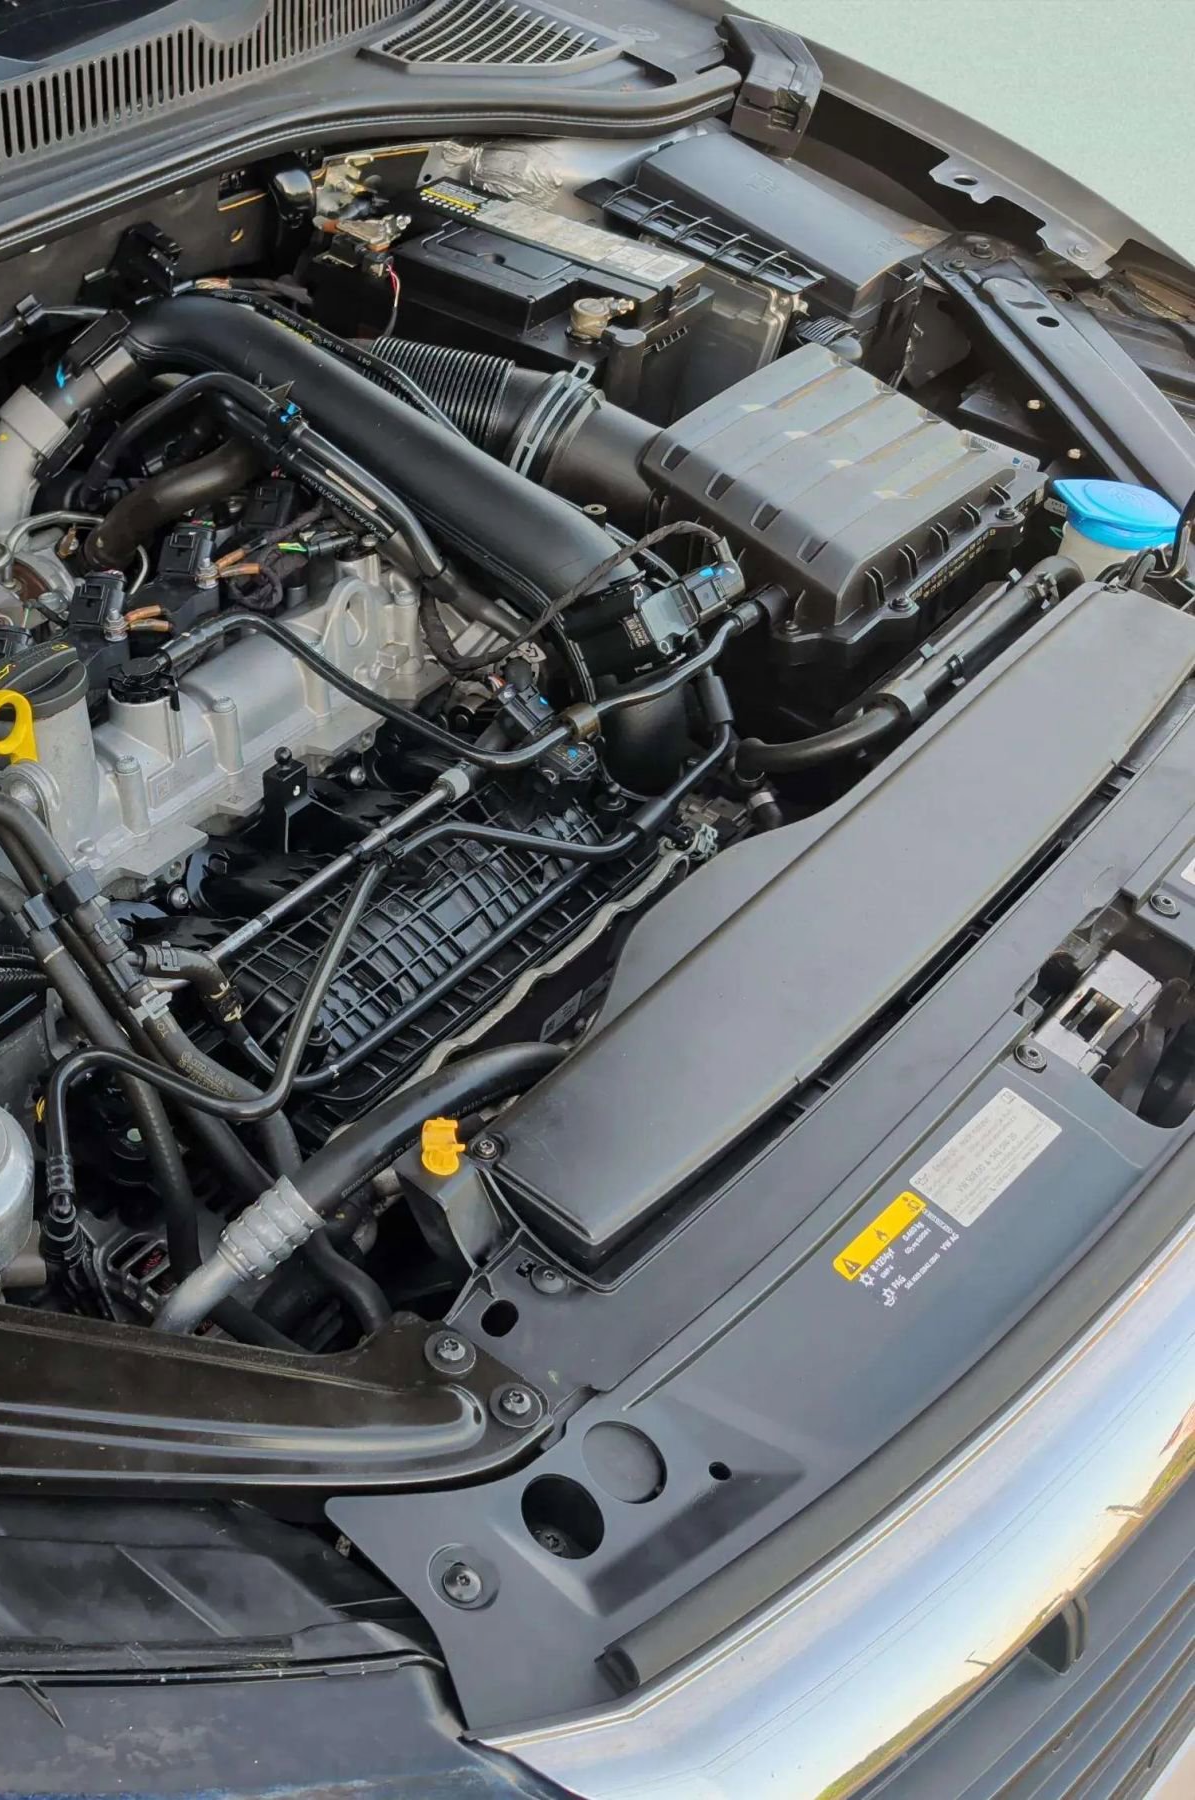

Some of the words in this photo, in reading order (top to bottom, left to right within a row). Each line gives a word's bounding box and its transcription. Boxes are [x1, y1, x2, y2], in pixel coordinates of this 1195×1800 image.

[940, 1239, 953, 1251] VW
[949, 1231, 960, 1243] AG
[891, 1274, 907, 1290] PAG
